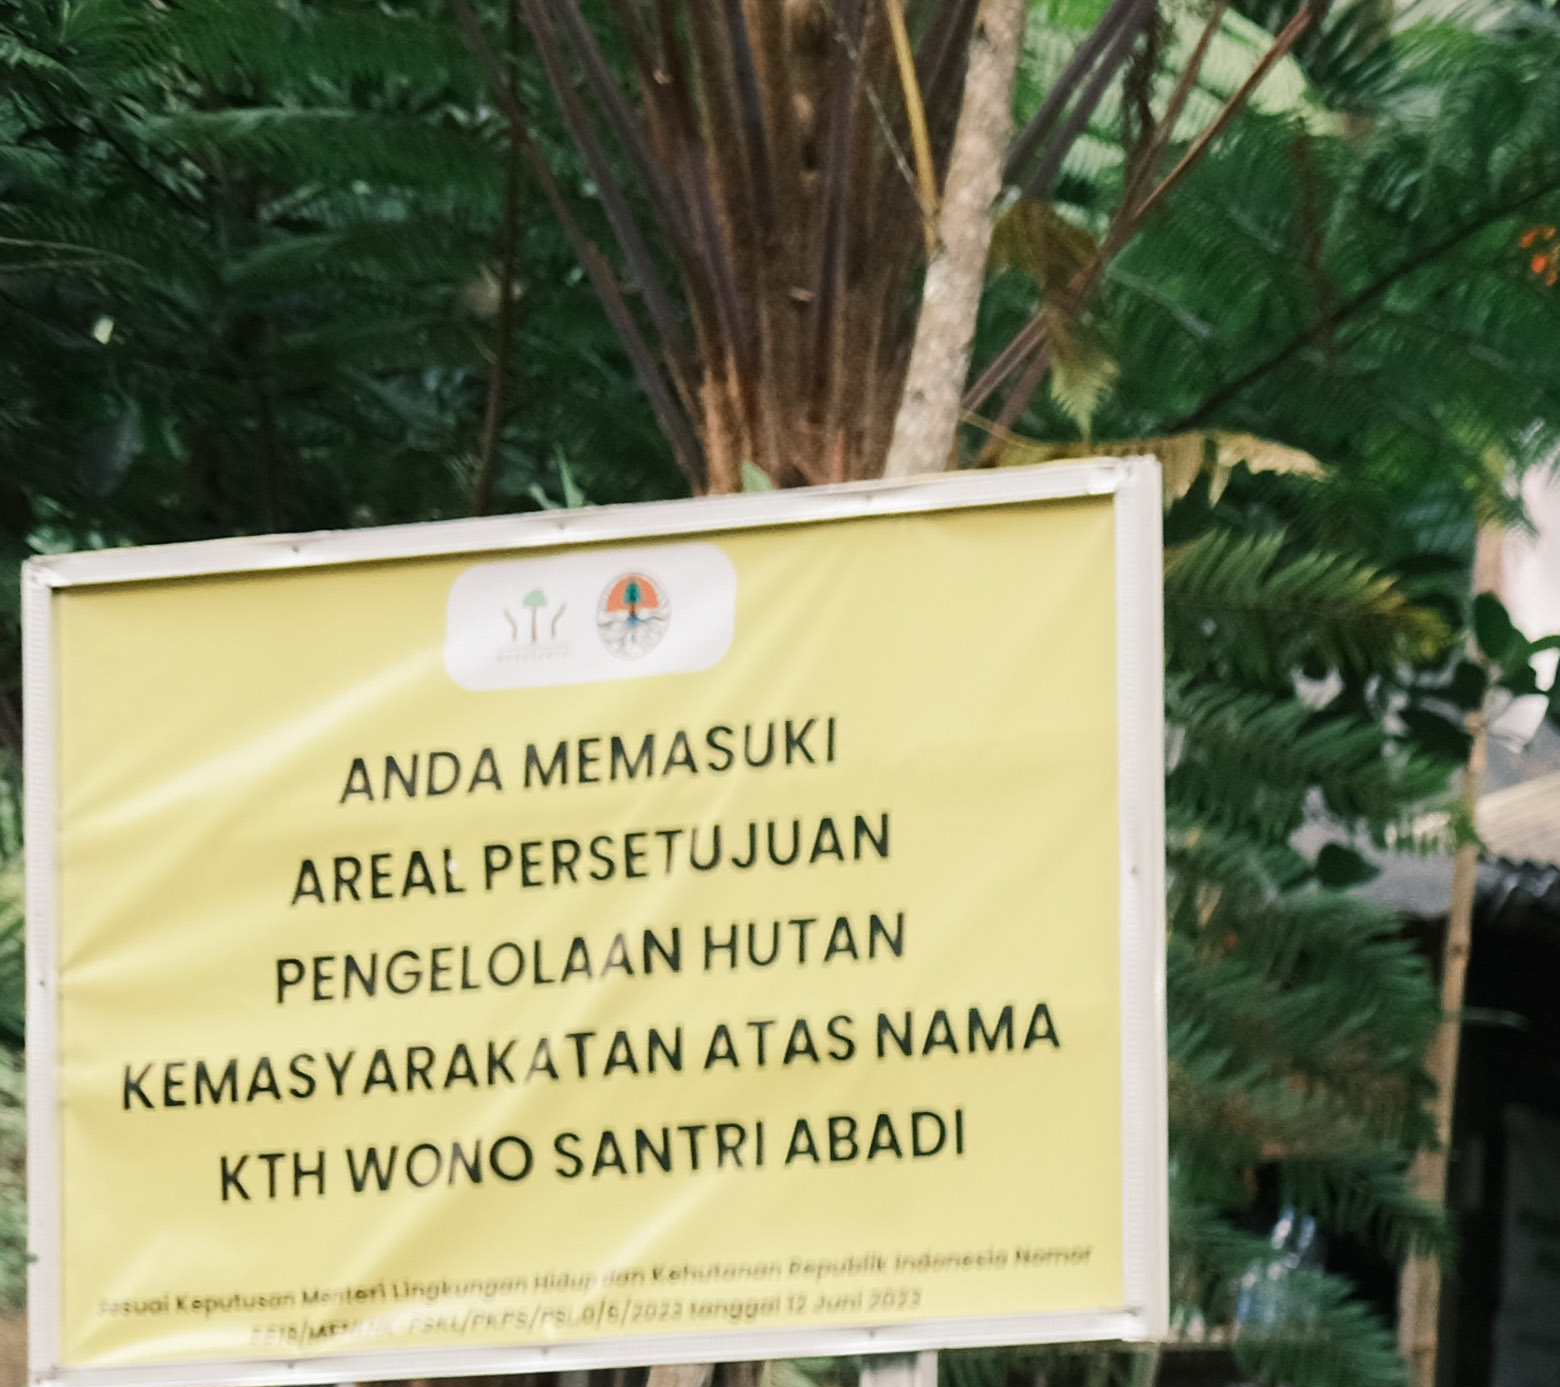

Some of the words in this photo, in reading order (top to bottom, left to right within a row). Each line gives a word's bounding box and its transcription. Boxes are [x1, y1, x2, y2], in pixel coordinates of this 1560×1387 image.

[338, 746, 504, 806] ANDA
[522, 715, 837, 790] MEMASUKI
[289, 846, 468, 907] AREAL
[482, 811, 891, 892] PERSETUJUAN
[274, 925, 683, 1006] PENGELOLAAN
[702, 910, 906, 972] HUTAN
[121, 1025, 684, 1113] KEMASYARAKATAN
[702, 1013, 858, 1073] ATAS
[875, 1000, 1062, 1062] NAMA
[218, 1148, 327, 1203] KTH
[343, 1133, 536, 1195] WONO
[552, 1118, 765, 1181] SANTRI
[783, 1107, 965, 1167] ABADI
[175, 1291, 296, 1320] Keputusan
[302, 1282, 386, 1304] Menteri
[392, 1277, 528, 1303] Lingkungan
[652, 1263, 781, 1282] Kehutanan
[788, 1254, 885, 1282] Republik
[895, 1248, 1008, 1270] Indonesia
[1015, 1244, 1092, 1266] Nomor
[690, 1295, 781, 1322] tanggal
